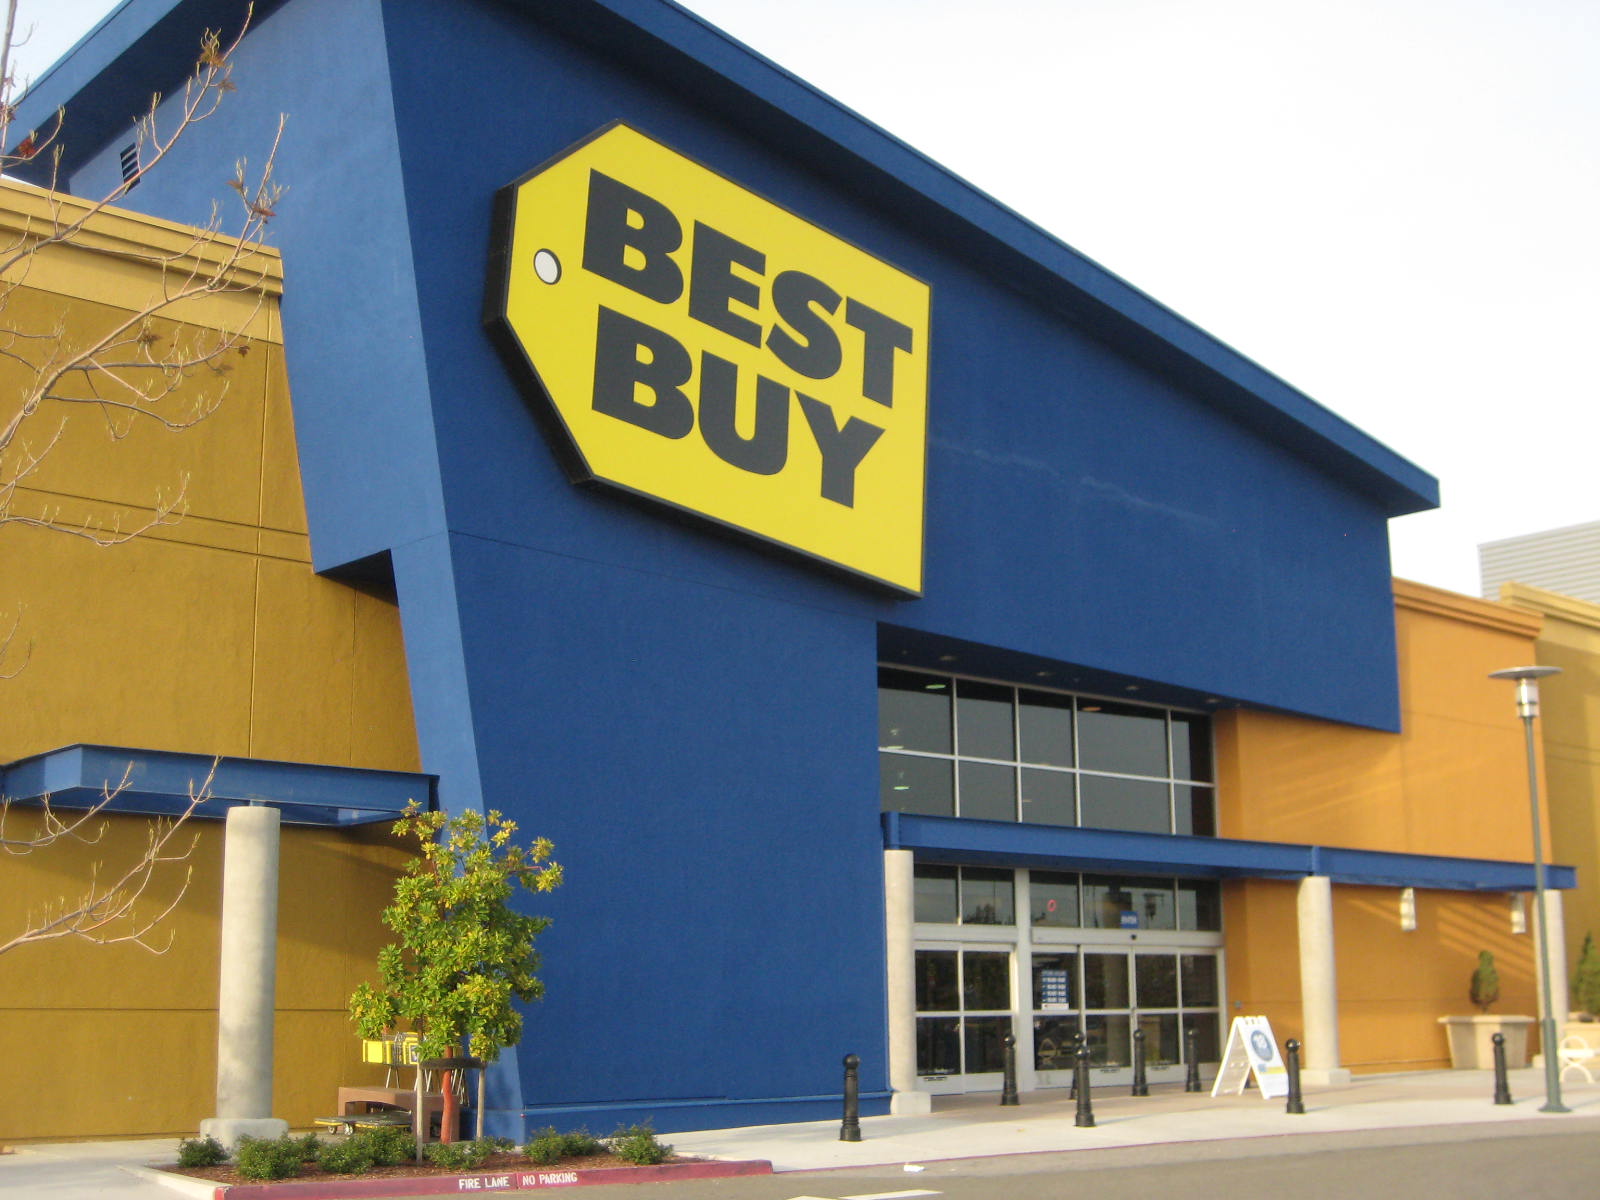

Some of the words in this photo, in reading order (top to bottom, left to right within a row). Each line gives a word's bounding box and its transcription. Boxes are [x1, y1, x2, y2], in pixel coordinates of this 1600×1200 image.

[582, 168, 913, 409] BEST
[591, 304, 886, 509] BUY
[458, 1178, 481, 1190] FIRE
[484, 1176, 510, 1188] LANE
[522, 1175, 536, 1186] NO
[539, 1172, 578, 1185] PARKING
